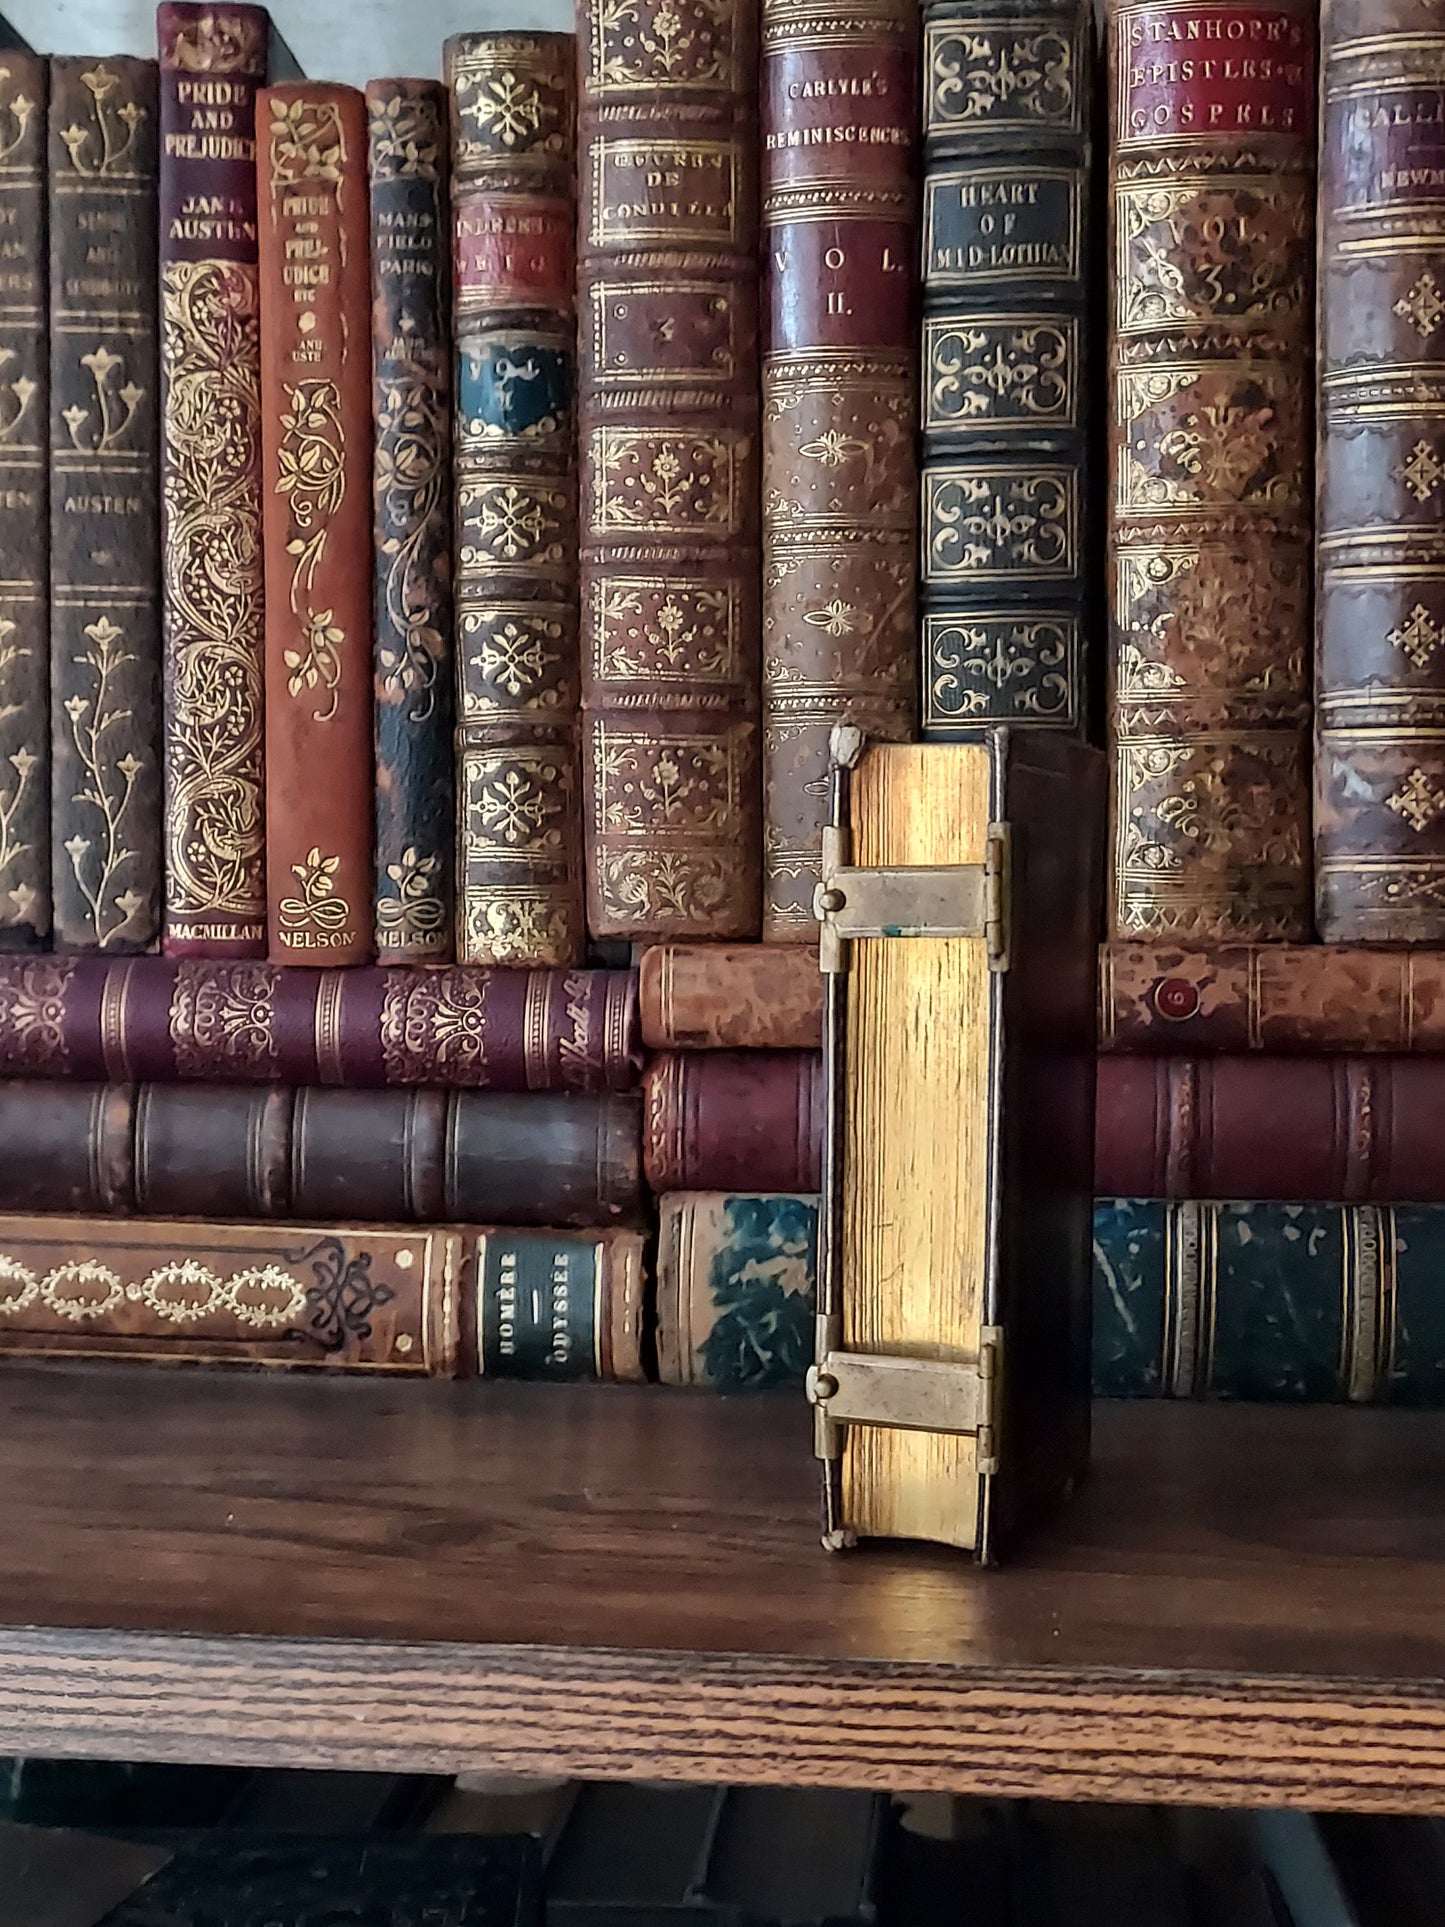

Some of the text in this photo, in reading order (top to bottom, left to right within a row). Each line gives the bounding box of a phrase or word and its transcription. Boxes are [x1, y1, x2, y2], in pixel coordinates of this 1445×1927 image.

[788, 70, 888, 99] CARLYLE'S
[191, 110, 234, 130] AND
[1131, 103, 1294, 129] GOSPELS
[647, 171, 681, 187] DE
[961, 183, 1038, 208] HEART
[980, 213, 1016, 235] OF
[379, 258, 434, 276] PARK
[774, 247, 903, 272] VOL.
[826, 292, 853, 315] II.
[64, 495, 140, 515] AUSTEN
[168, 923, 263, 940] MACMILLAN
[278, 931, 357, 948] NELSON
[376, 930, 449, 948] NELSON
